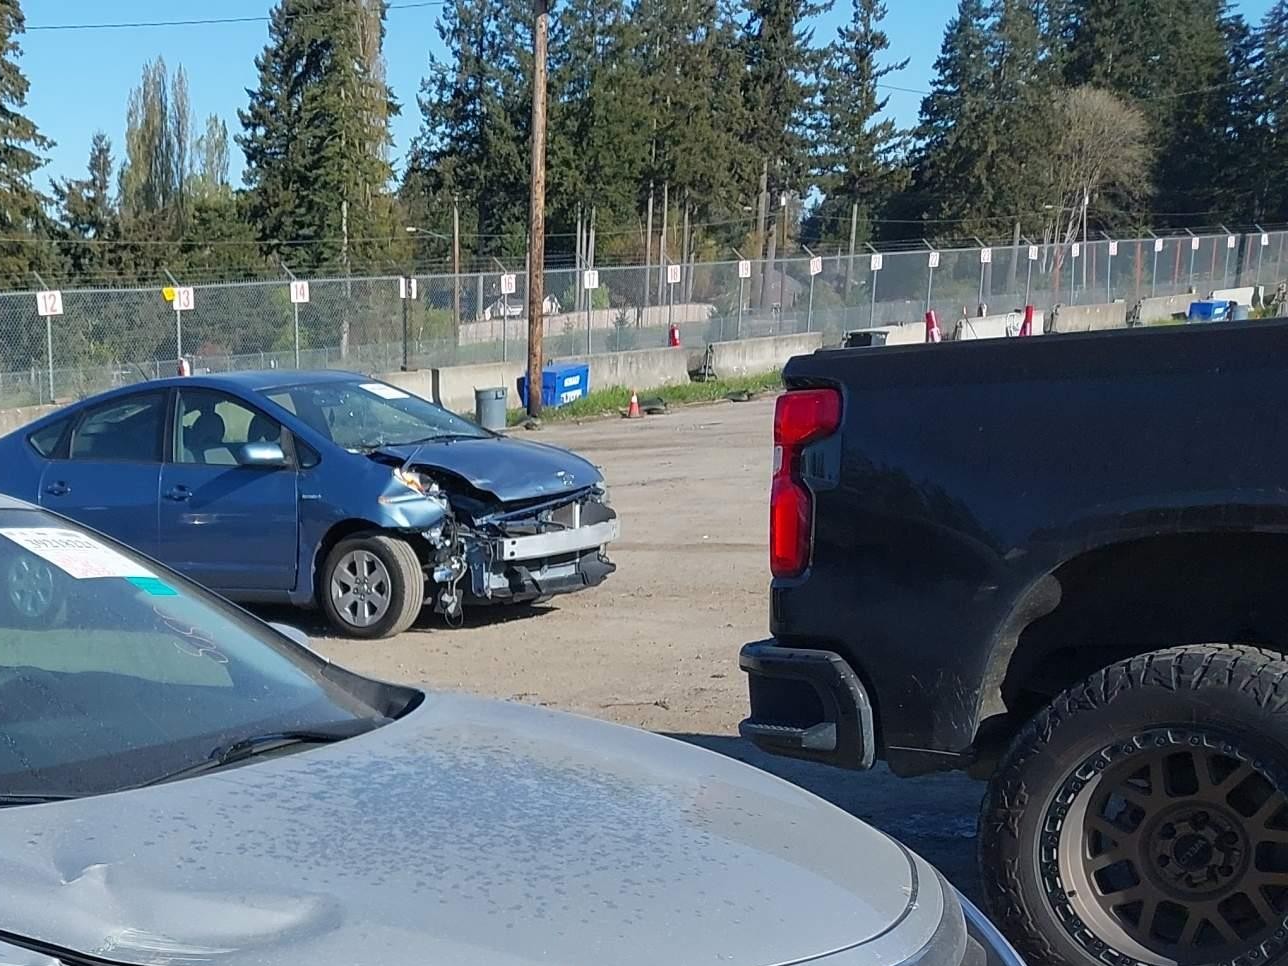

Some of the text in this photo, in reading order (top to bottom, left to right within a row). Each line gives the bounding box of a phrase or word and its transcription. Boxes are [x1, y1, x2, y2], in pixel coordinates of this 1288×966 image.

[741, 261, 749, 276] 19
[812, 258, 821, 273] 20
[872, 255, 880, 269] 21
[587, 271, 596, 286] 17
[669, 266, 679, 281] 18
[503, 275, 513, 292] 16
[177, 288, 190, 308] 13
[294, 282, 305, 301] 14
[42, 293, 58, 313] 12
